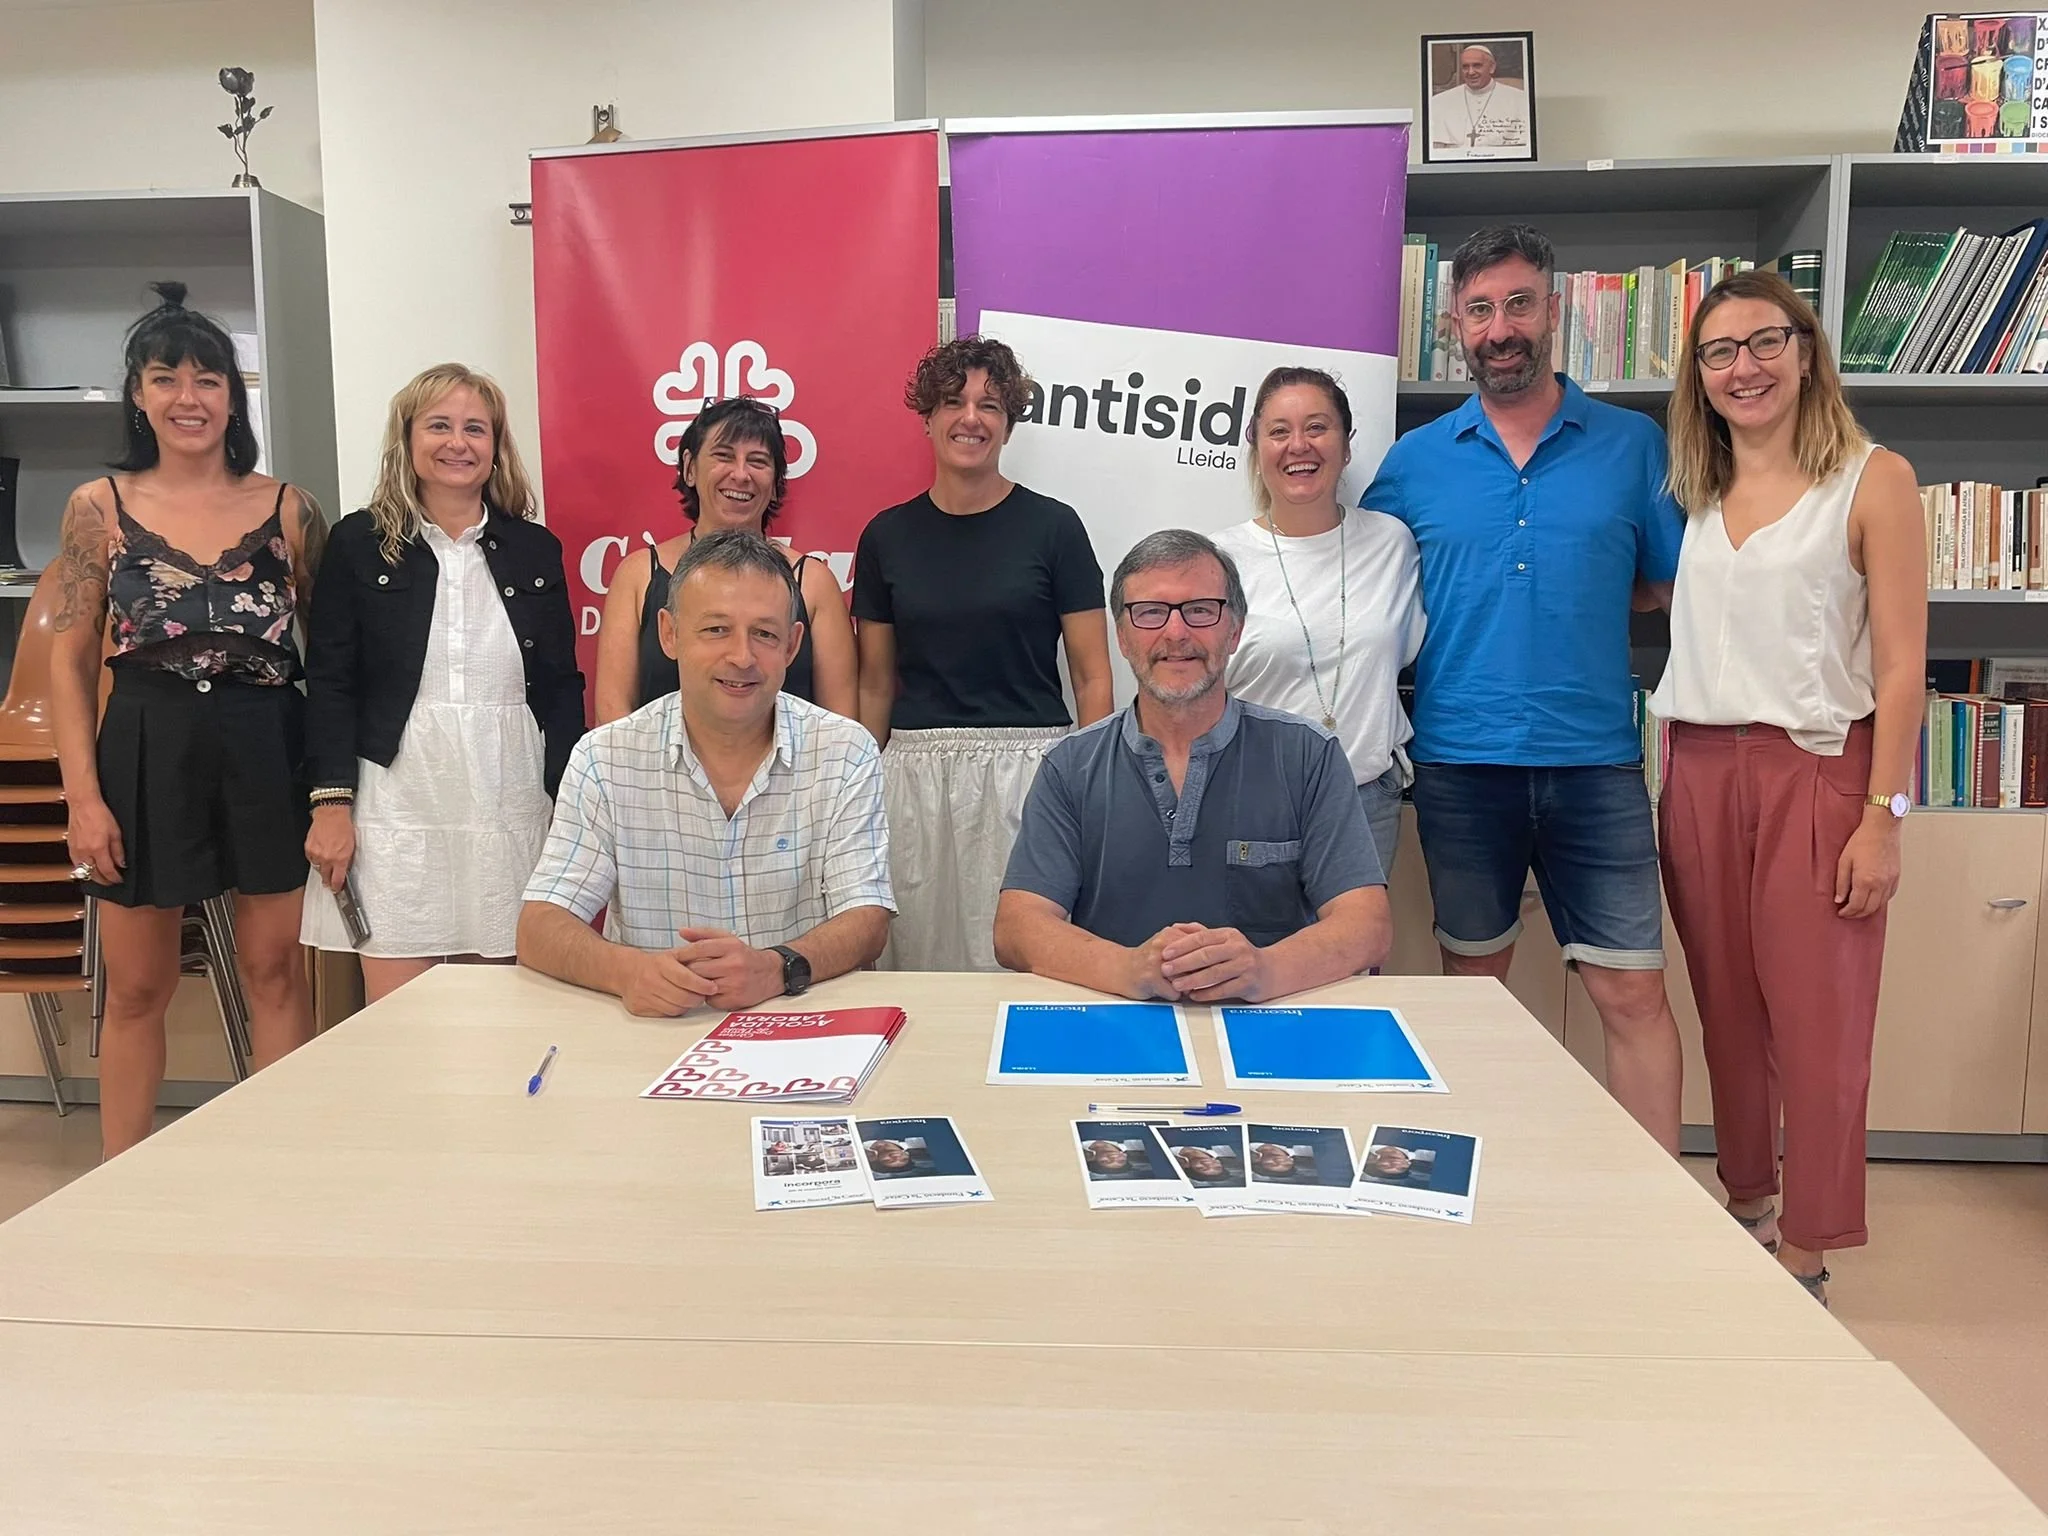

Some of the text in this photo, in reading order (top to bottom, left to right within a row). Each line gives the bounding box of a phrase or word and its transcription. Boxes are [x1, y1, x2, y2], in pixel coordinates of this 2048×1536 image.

[2037, 18, 2048, 31] X
[1018, 372, 1247, 447] antisid
[1177, 447, 1237, 471] Lleida
[1015, 1004, 1087, 1013] Incorpora
[1229, 1008, 1303, 1017] Incorpora
[737, 1014, 826, 1022] LABORAL
[730, 1018, 835, 1028] ACOLLIDA
[783, 1179, 841, 1188] incorpora
[923, 1190, 964, 1199] Fundació
